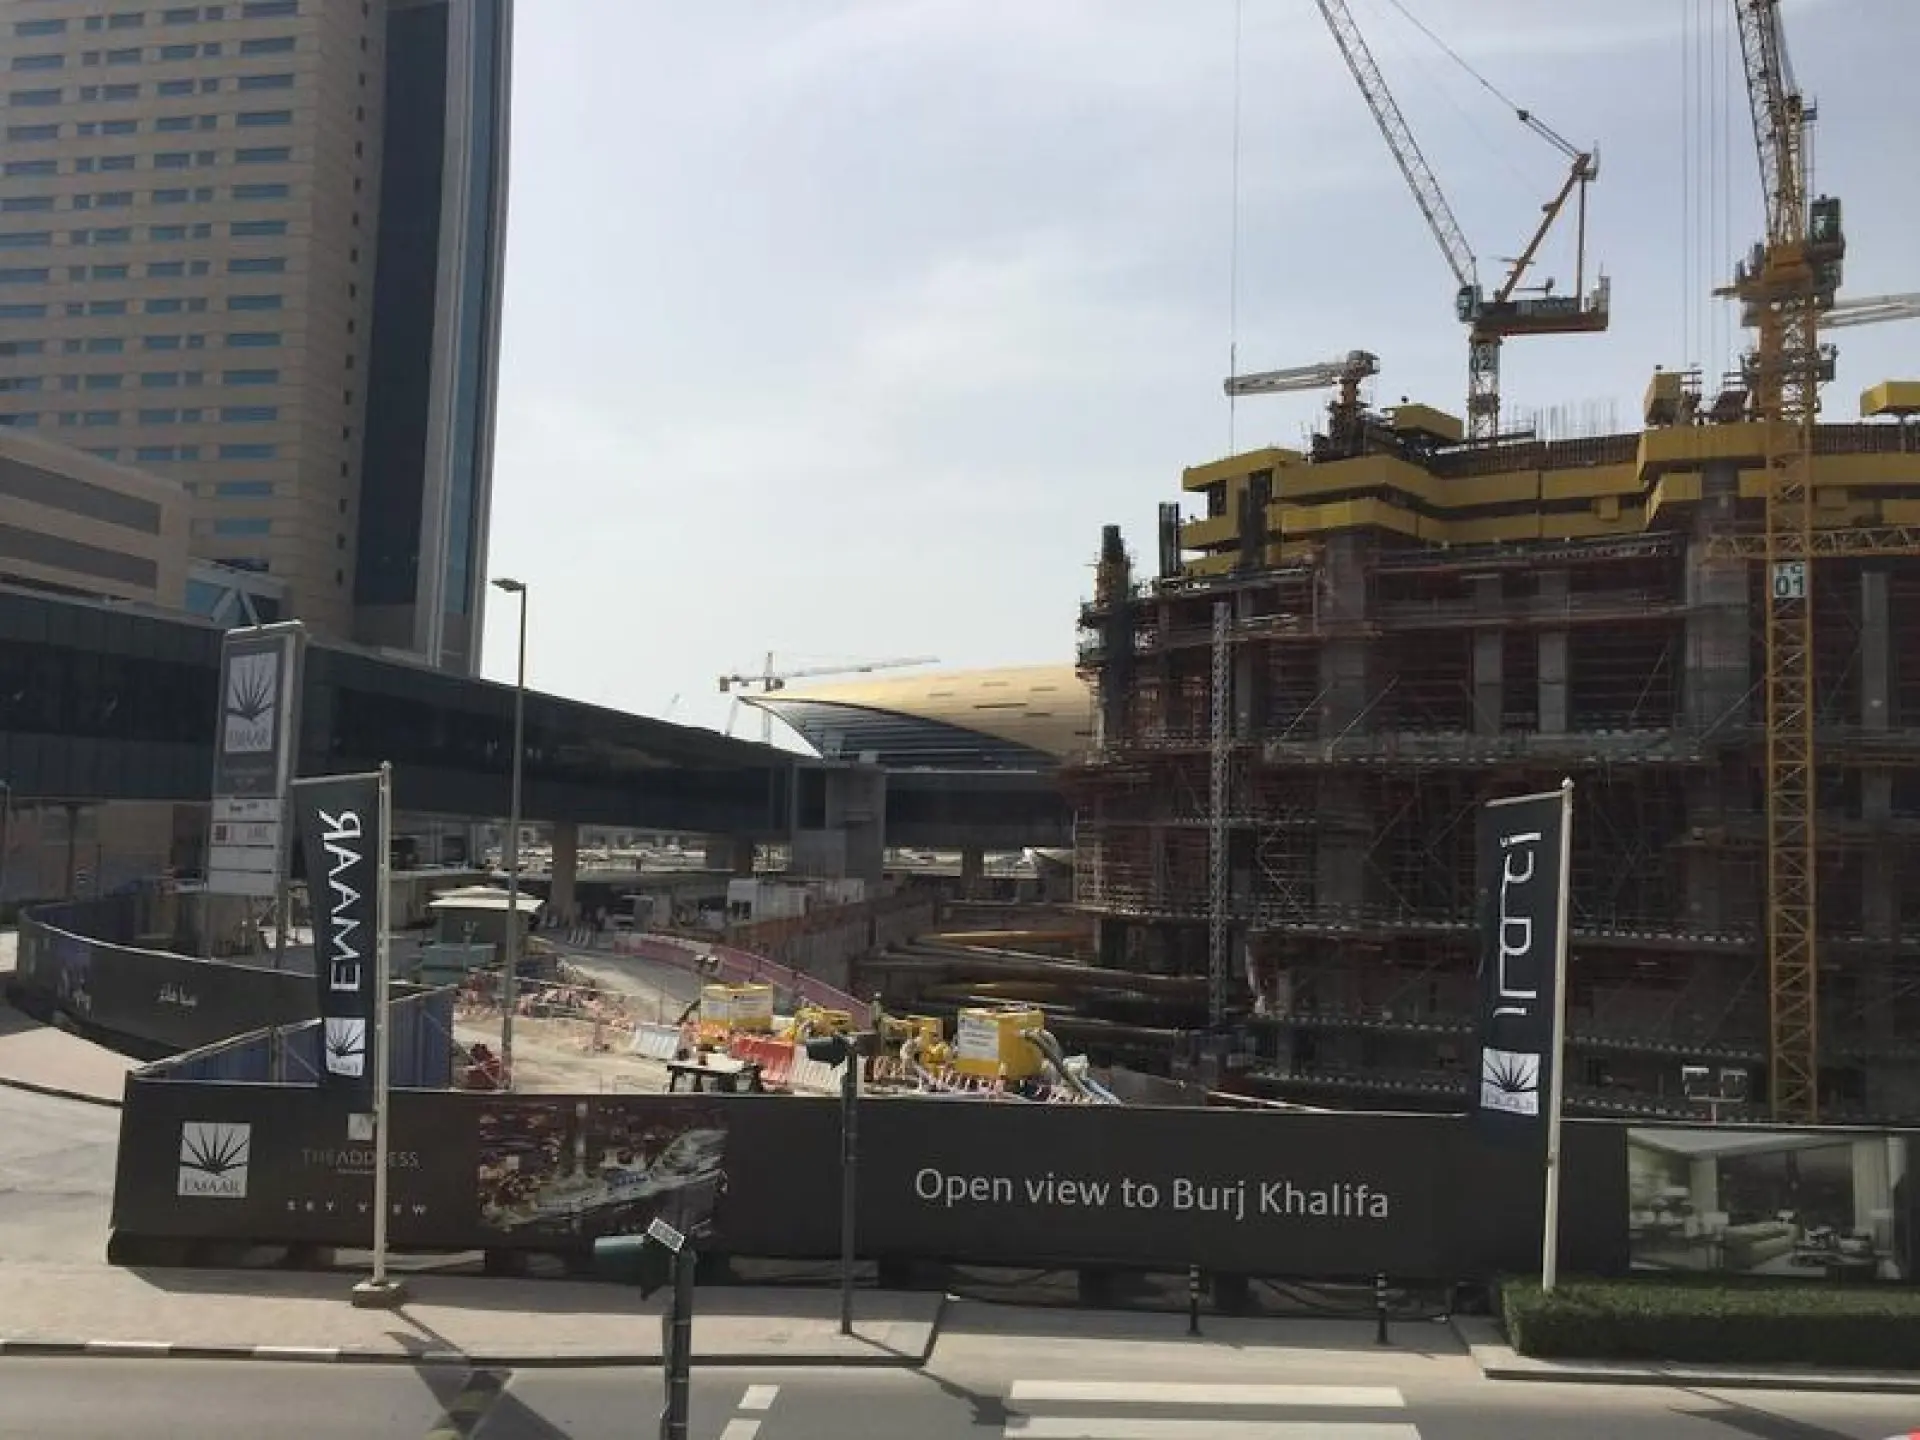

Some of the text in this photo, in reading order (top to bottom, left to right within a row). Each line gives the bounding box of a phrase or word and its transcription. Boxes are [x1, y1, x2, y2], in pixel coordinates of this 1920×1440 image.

[1775, 575, 1804, 596] 01
[915, 1168, 1390, 1220] Open view to Burj Khalifa
[357, 1202, 427, 1216] VEW
